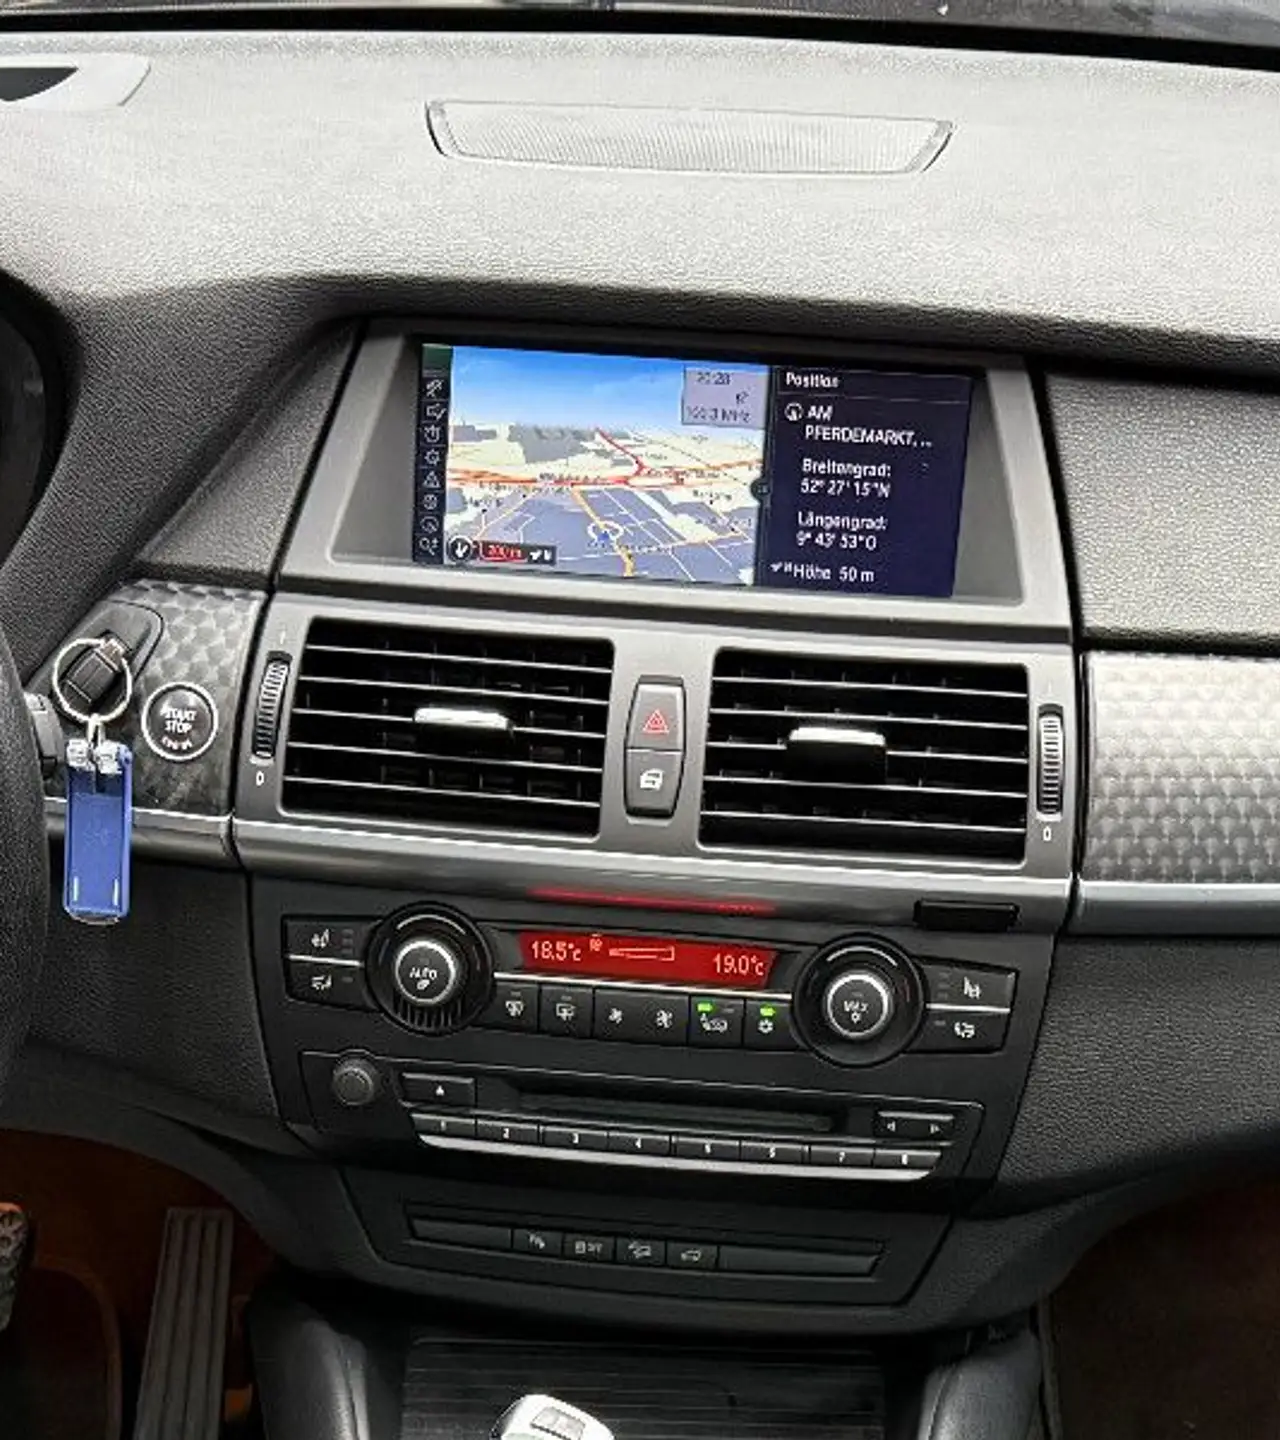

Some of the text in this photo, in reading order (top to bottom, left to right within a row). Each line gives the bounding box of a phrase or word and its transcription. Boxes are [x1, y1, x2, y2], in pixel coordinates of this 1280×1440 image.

[786, 372, 839, 389] Position
[807, 405, 833, 421] AM
[839, 566, 857, 582] 50
[860, 569, 875, 582] m
[165, 720, 193, 733] STOP
[502, 1127, 510, 1139] 2
[571, 1132, 580, 1144] 3
[634, 1137, 643, 1149] 4
